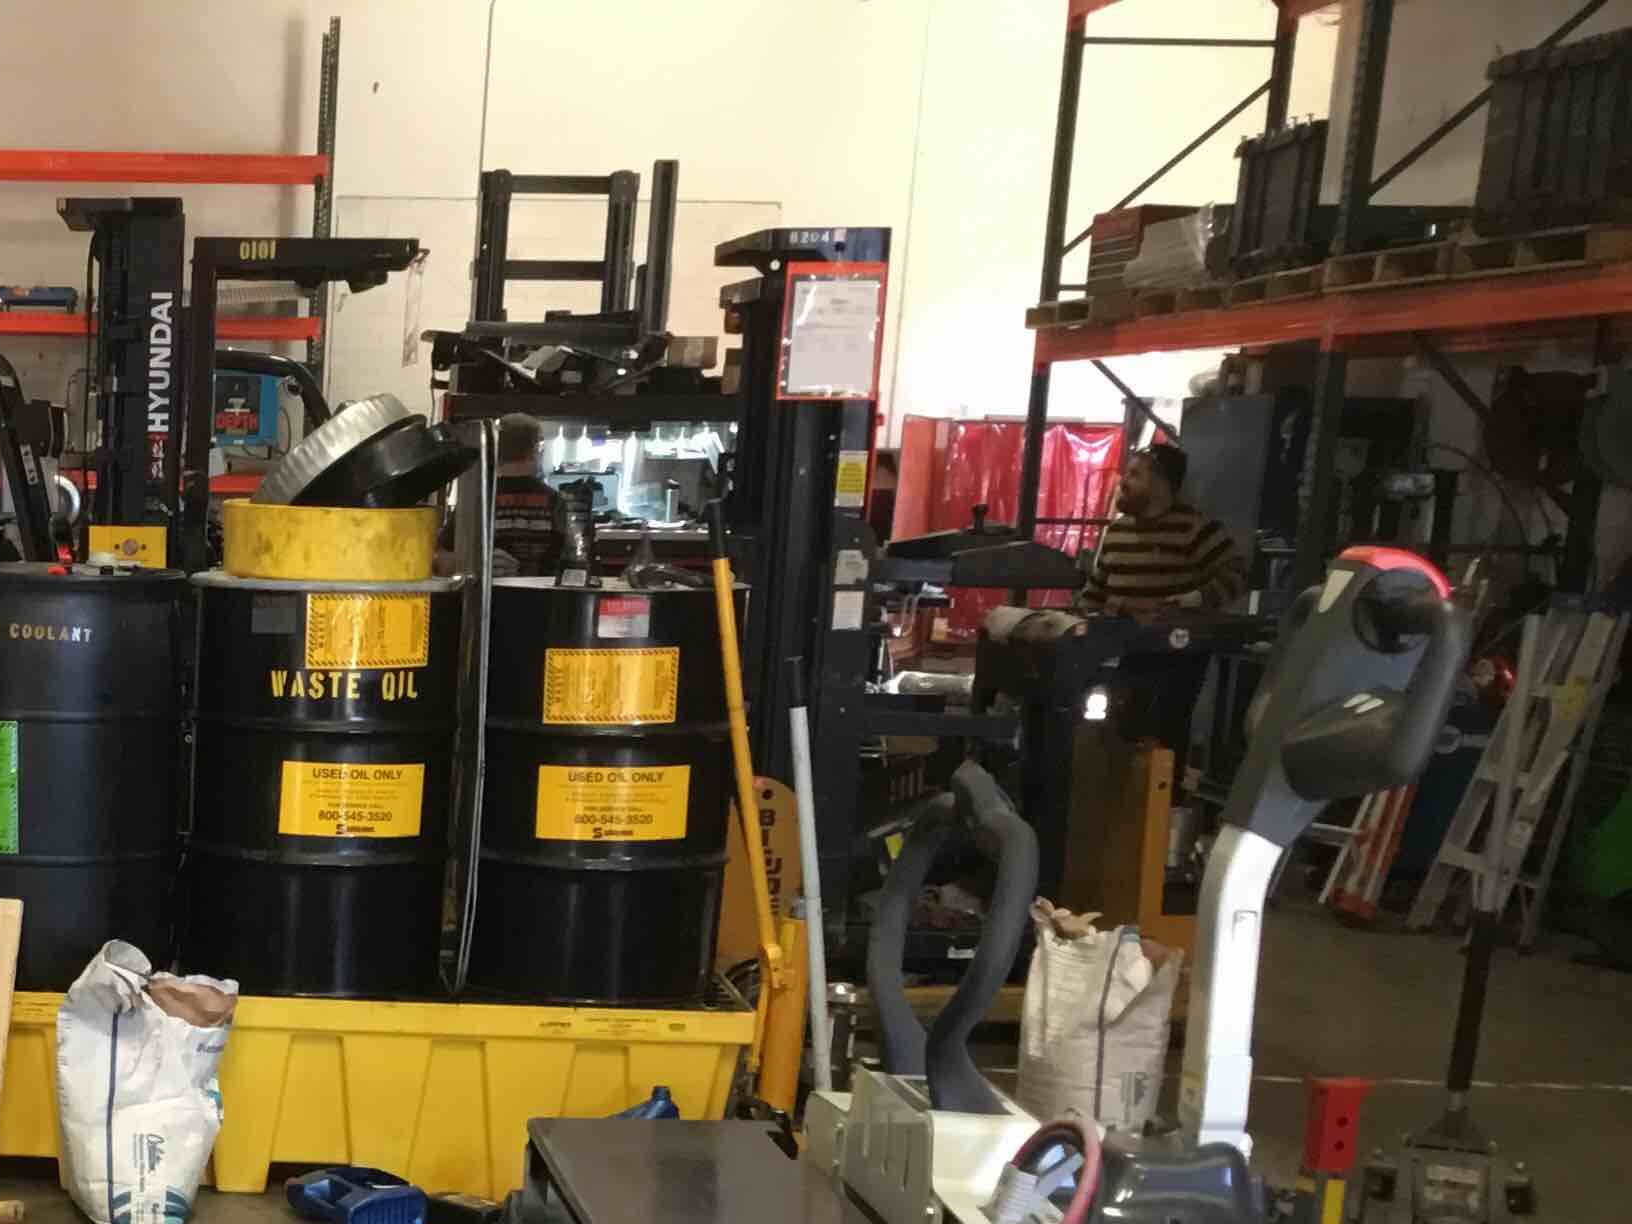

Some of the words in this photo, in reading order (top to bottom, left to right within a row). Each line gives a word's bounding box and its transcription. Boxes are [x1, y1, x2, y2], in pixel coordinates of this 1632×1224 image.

[147, 292, 173, 432] HYUNDAI
[9, 623, 93, 642] COOLANT
[270, 669, 361, 699] WASTE
[381, 670, 418, 701] OIL
[312, 768, 348, 780] USED
[350, 769, 371, 780] OIL
[373, 769, 403, 780] ONLY
[568, 772, 604, 783] USED
[607, 772, 629, 783] OIL
[631, 772, 665, 783] ONLY
